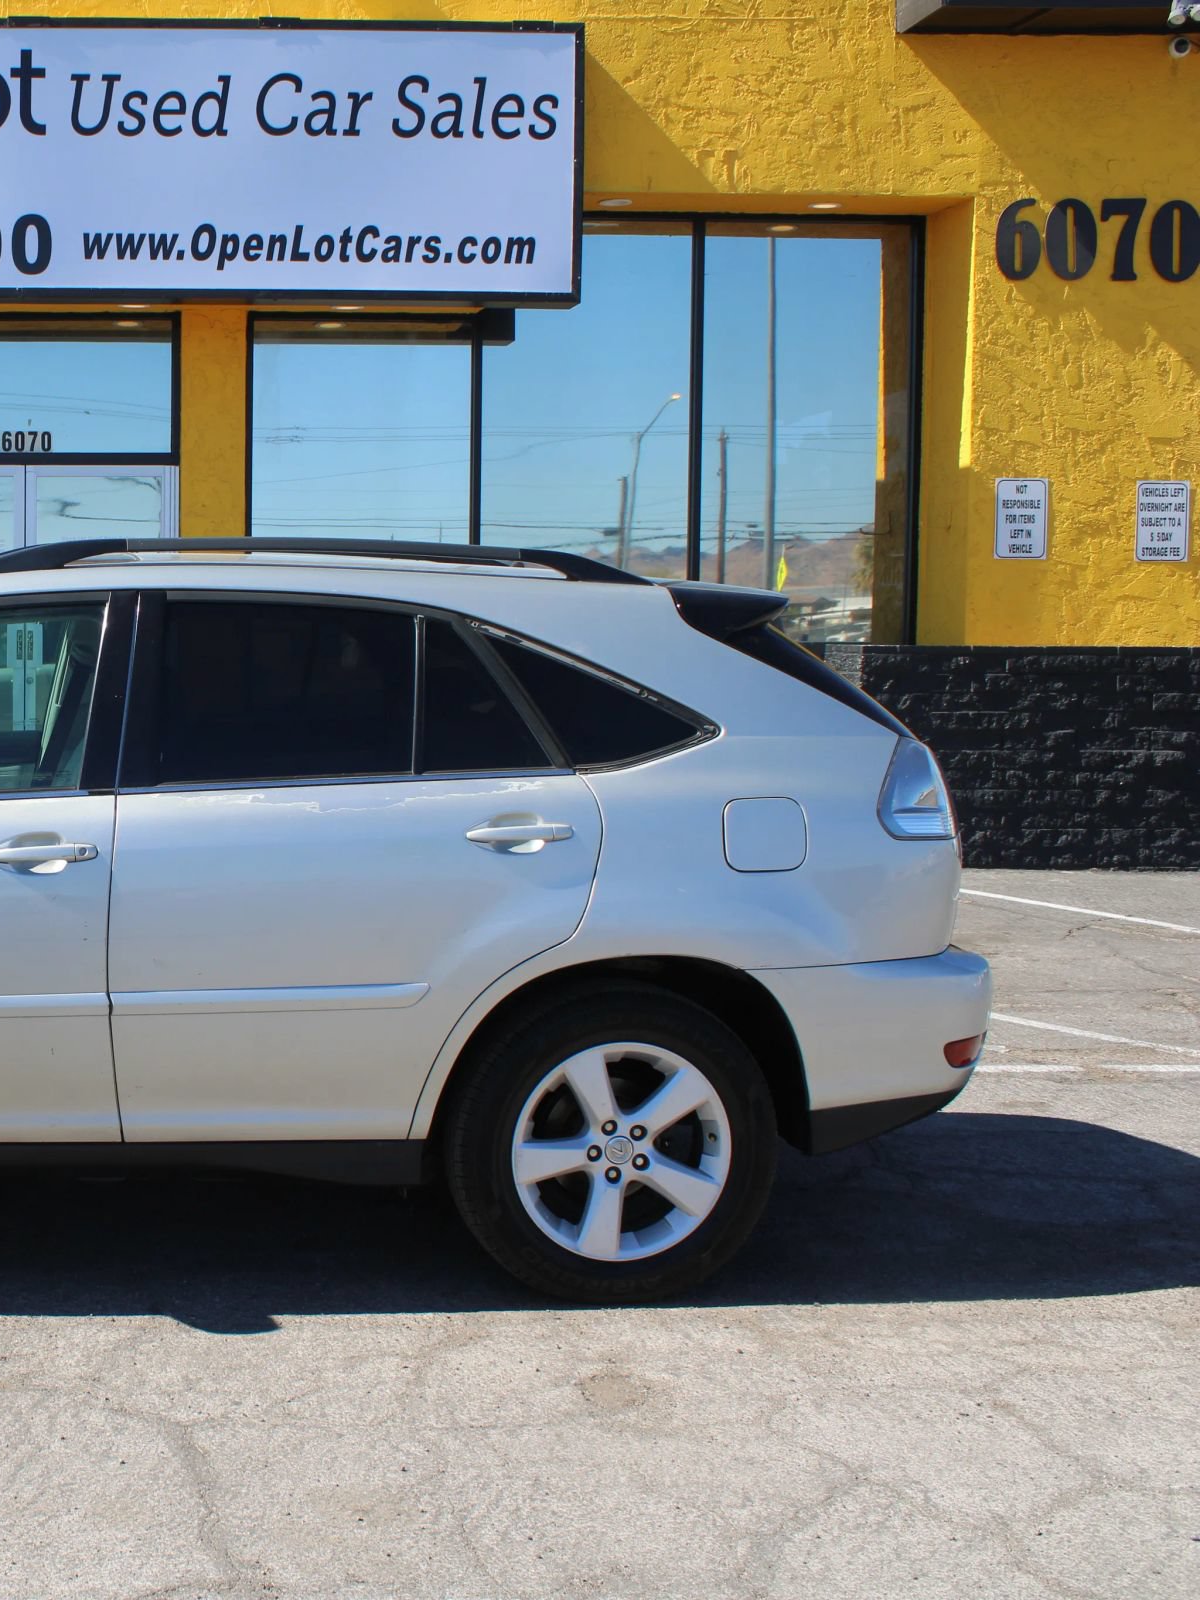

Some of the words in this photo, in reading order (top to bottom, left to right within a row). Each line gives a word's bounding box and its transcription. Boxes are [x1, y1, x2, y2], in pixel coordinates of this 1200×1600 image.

[69, 73, 232, 138] Used
[255, 72, 374, 138] Car
[391, 74, 559, 141] Sales
[995, 198, 1200, 282] 6070
[82, 223, 536, 271] www.OpenLotCars.com
[1, 430, 52, 453] 6070
[1015, 485, 1028, 494] NOT
[1141, 488, 1169, 498] VEHICLES
[1170, 488, 1185, 498] LEFT
[1002, 499, 1041, 509] RESPONSIBLE
[1139, 502, 1173, 512] OVERNIGHT
[1174, 503, 1186, 512] ARE
[1005, 514, 1017, 524] FOR
[1017, 514, 1035, 524] ITEMS
[1140, 517, 1167, 527] SUBJECT
[1168, 517, 1176, 527] TO
[1010, 529, 1024, 539] LEFT
[1025, 529, 1032, 539] IN
[1008, 544, 1033, 554] VEHICLE
[1141, 547, 1168, 557] STORAGE
[1169, 547, 1180, 557] FEE
